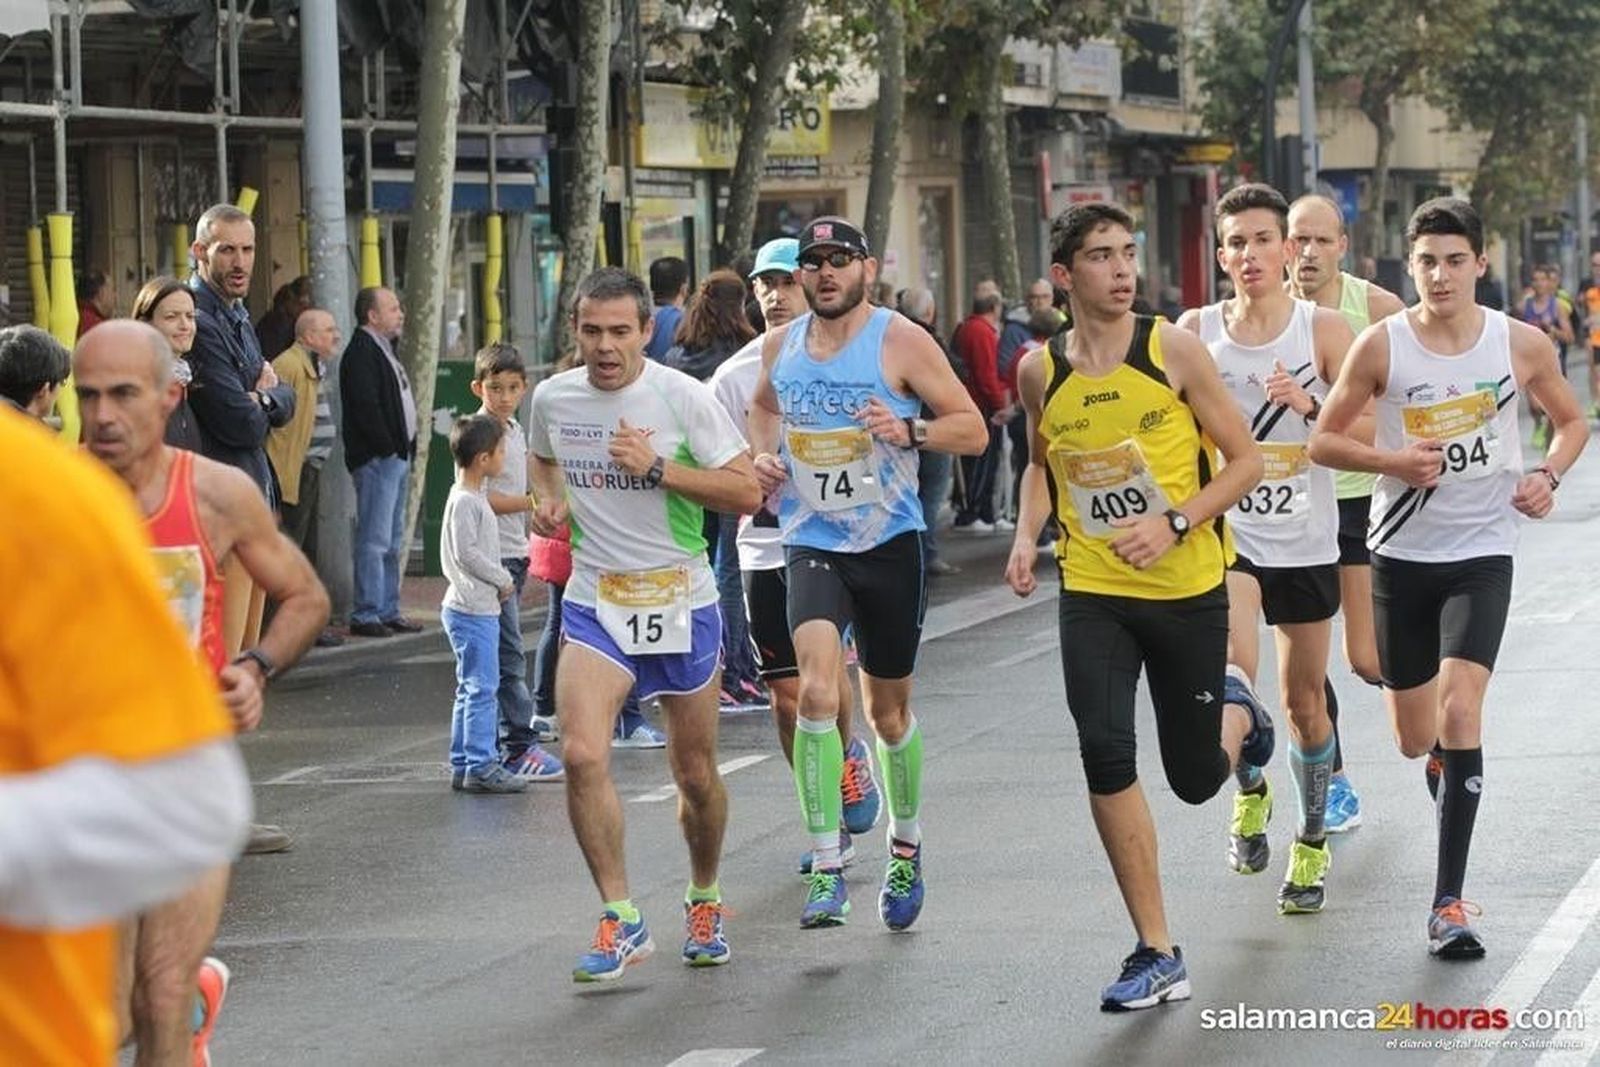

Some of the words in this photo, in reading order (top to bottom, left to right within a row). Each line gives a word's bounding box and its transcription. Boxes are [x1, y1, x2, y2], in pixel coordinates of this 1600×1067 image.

[814, 470, 854, 501] 74
[1091, 487, 1148, 524] 409
[626, 613, 663, 645] 15
